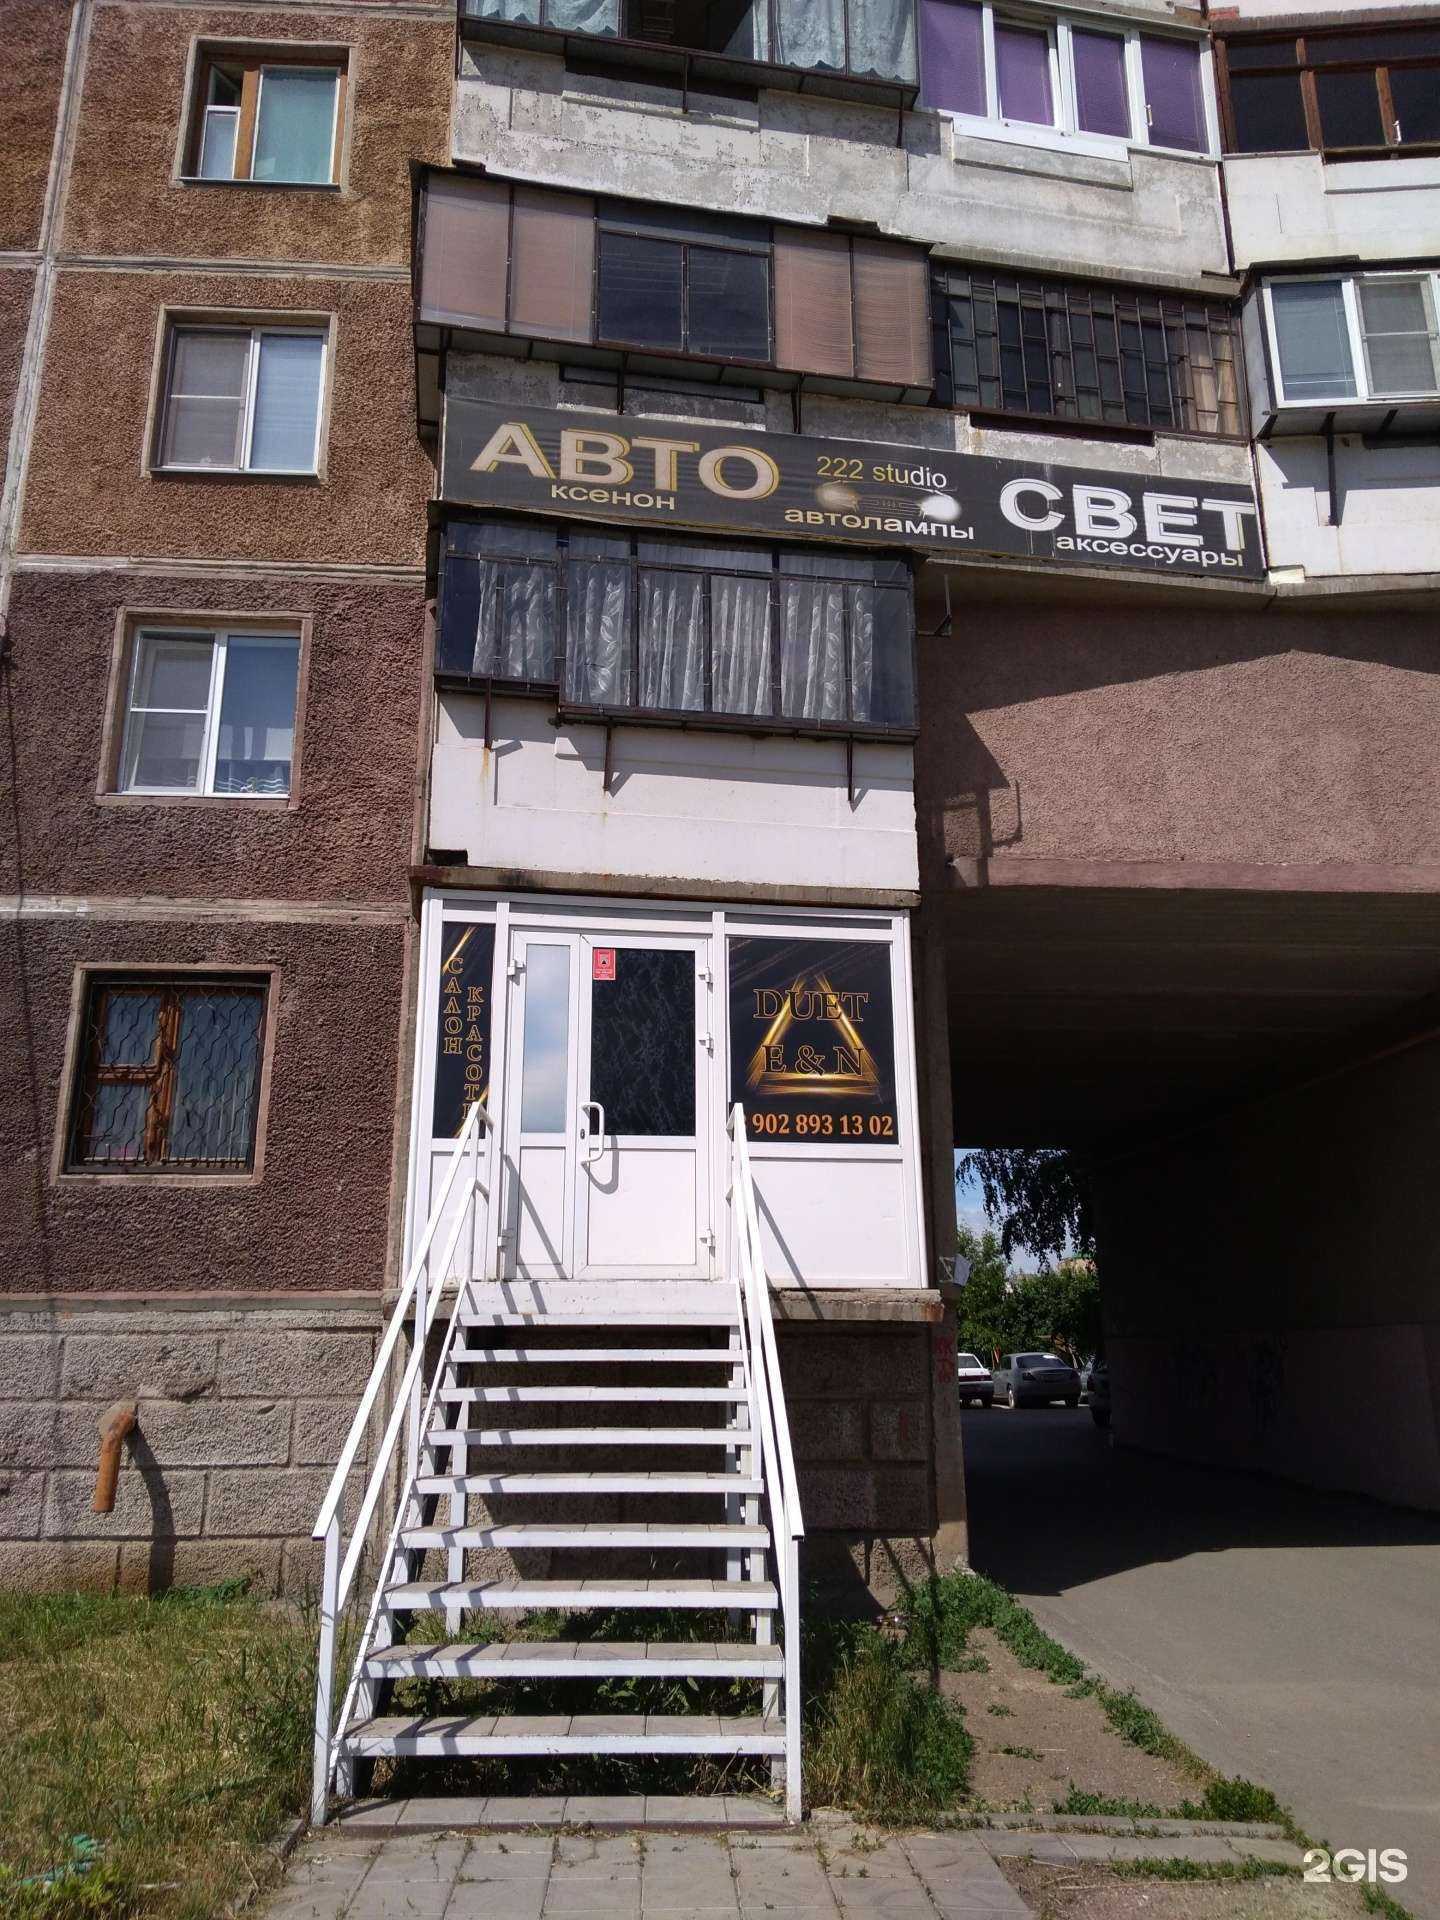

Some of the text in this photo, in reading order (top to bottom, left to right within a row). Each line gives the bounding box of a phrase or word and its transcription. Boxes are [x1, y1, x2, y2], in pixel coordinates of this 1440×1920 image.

[470, 422, 780, 500] АВТО
[816, 456, 947, 488] 222 studio
[551, 484, 676, 511] ксенон
[784, 509, 975, 540] автолампы
[1000, 478, 1256, 551] СВЕТ
[1056, 536, 1243, 568] аксессуары
[443, 957, 464, 1055] САЛОН
[752, 988, 869, 1022] DUET
[760, 1044, 865, 1077] E & N
[751, 1113, 894, 1136] 902 893 13 02
